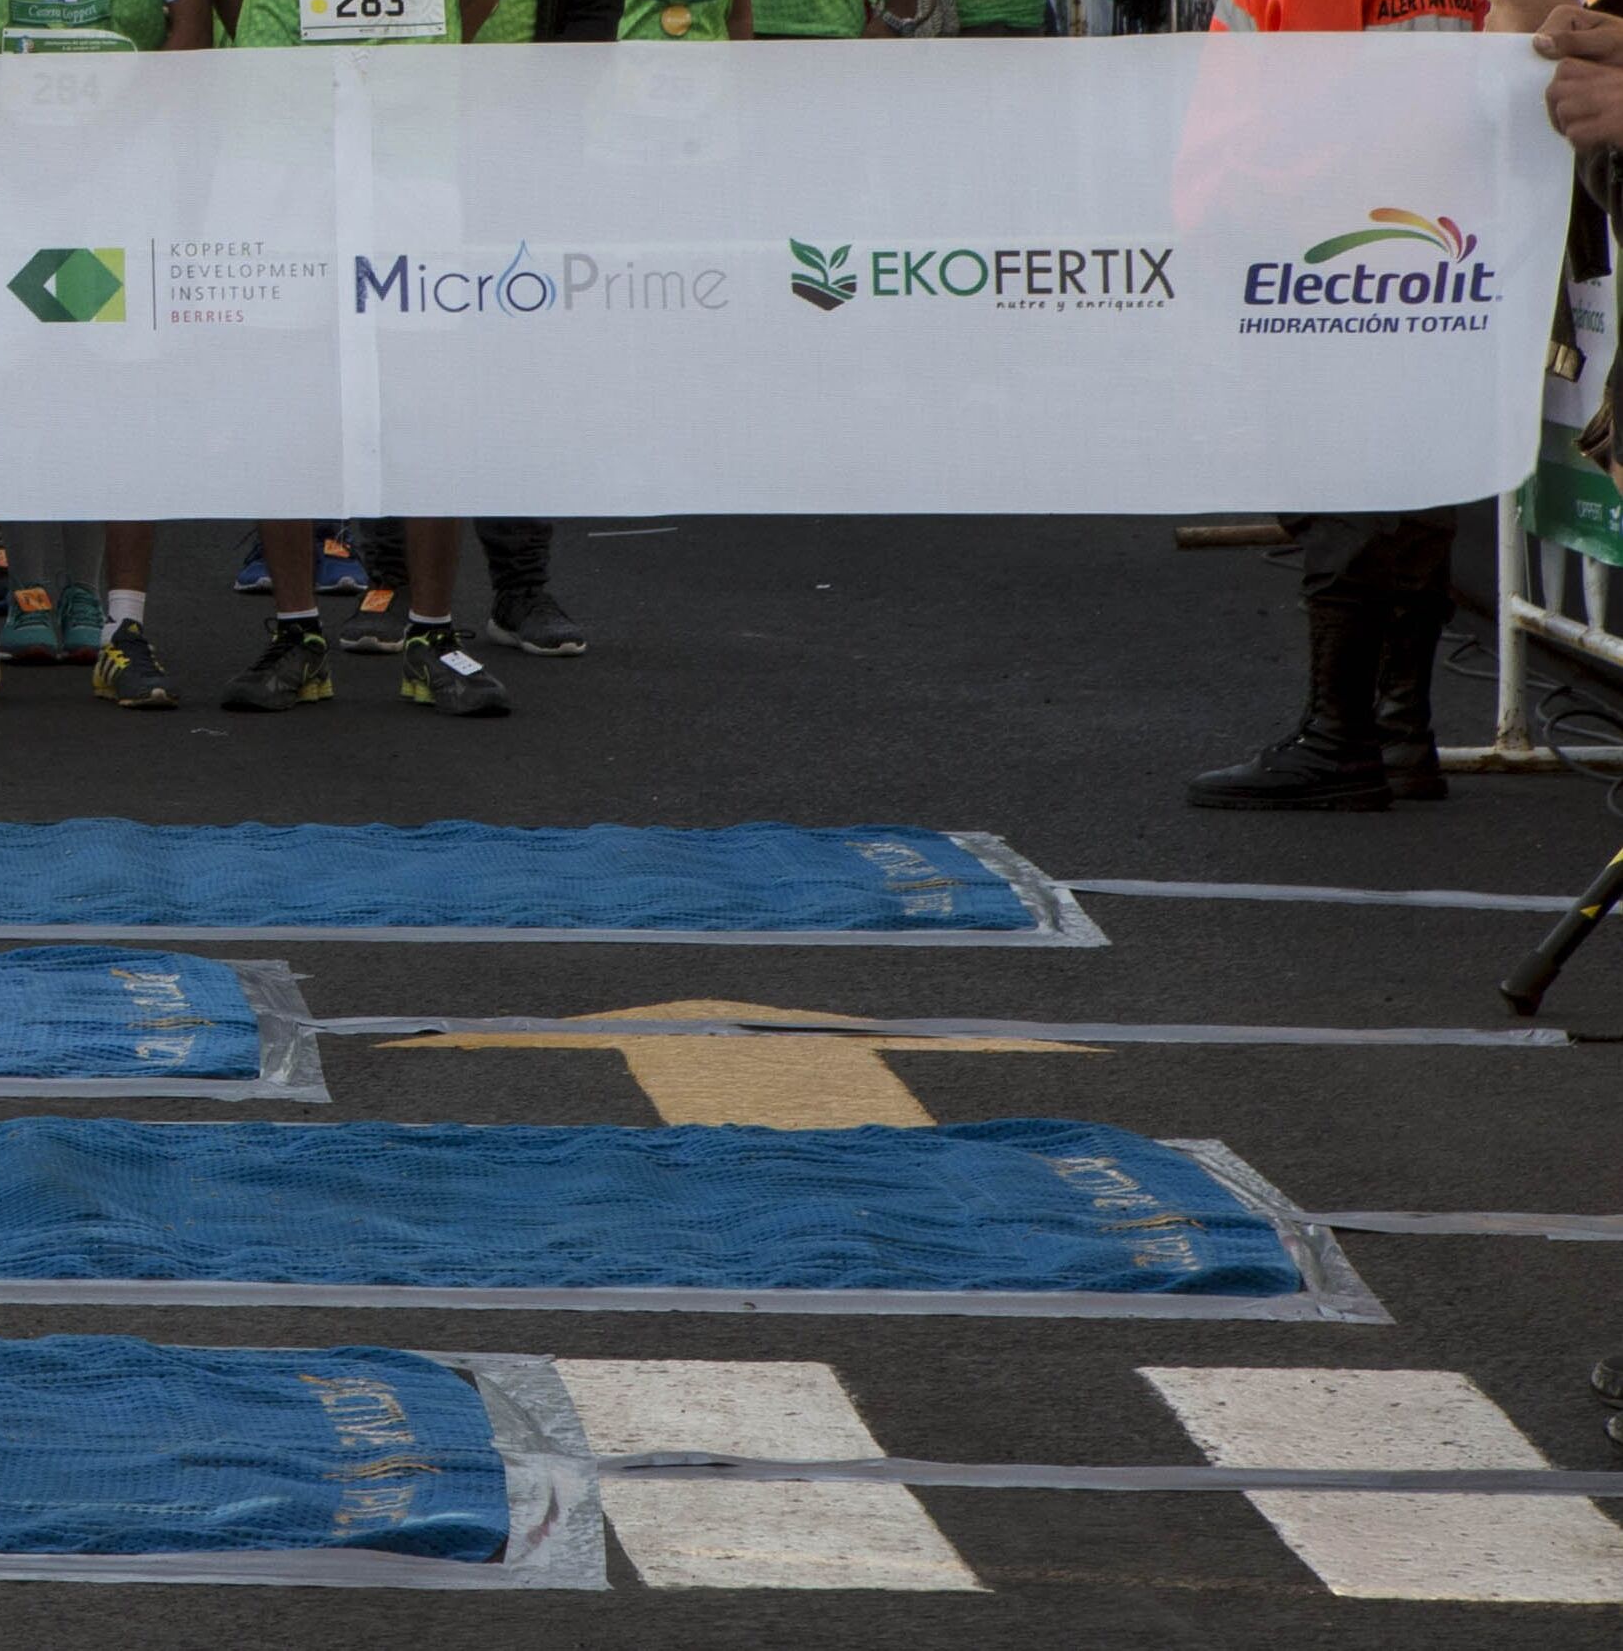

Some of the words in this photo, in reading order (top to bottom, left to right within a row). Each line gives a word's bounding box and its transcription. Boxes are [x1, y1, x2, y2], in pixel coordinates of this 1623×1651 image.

[170, 240, 264, 257] KOPPERT
[170, 262, 328, 280] DEVELOPMENT
[872, 247, 1175, 300] EKOFERTIX
[1244, 257, 1499, 305] Electrolit
[171, 286, 280, 301] INSTITUTE
[171, 310, 244, 323] BERRIES
[1240, 313, 1400, 333] ¡HIDRATACIÓN
[1406, 315, 1488, 333] TOTAL!
